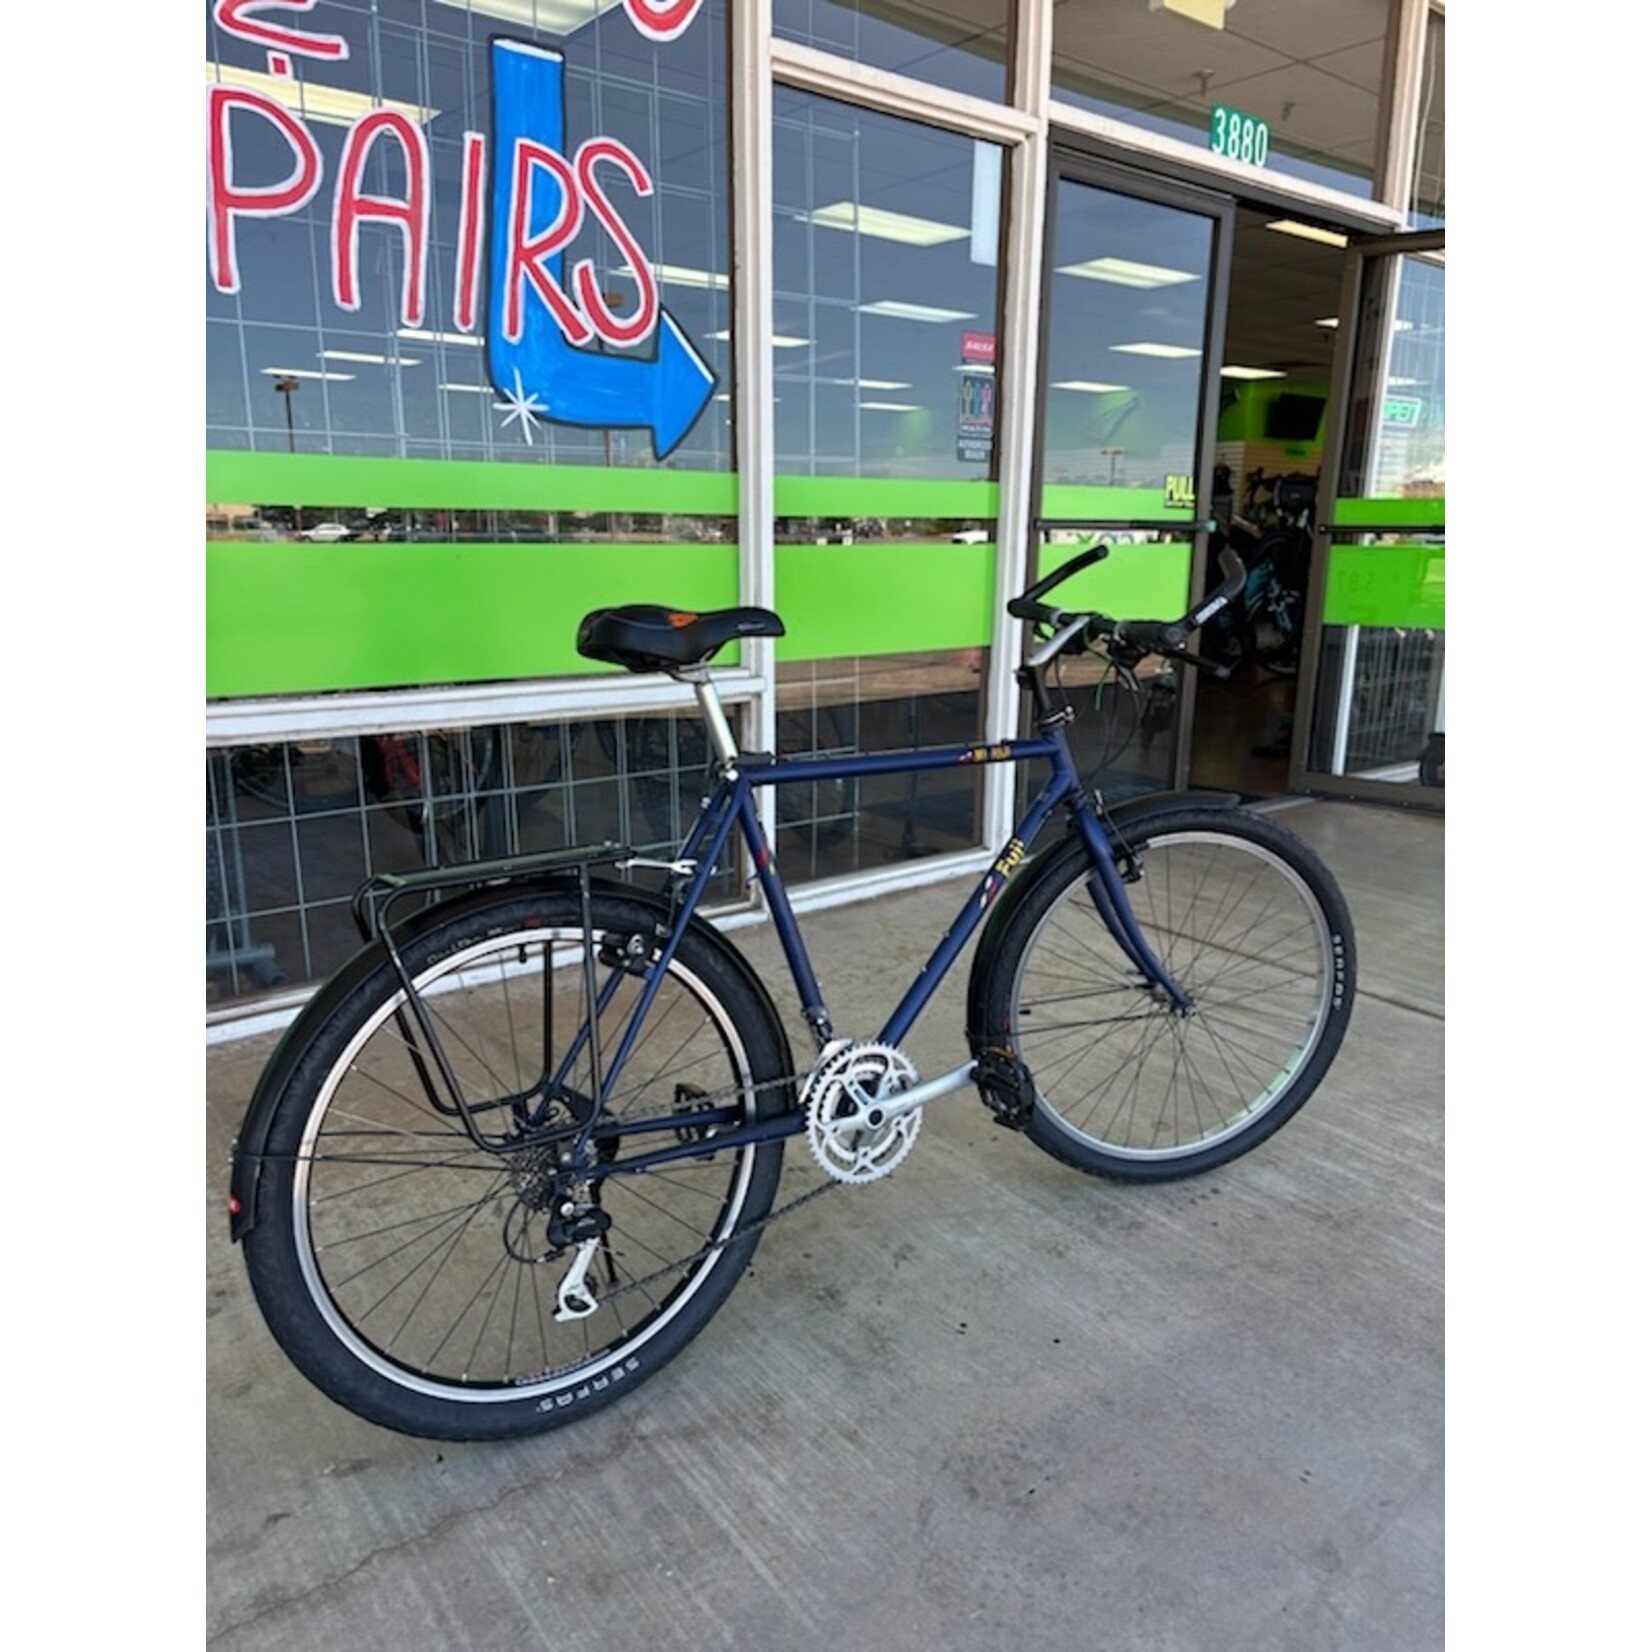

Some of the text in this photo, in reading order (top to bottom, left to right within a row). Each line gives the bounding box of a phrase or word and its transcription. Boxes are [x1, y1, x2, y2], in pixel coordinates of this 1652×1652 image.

[1212, 108, 1268, 167] 3880
[206, 85, 658, 348] PAIRS
[1165, 475, 1195, 501] PULL
[995, 838, 1025, 877] Fuji
[536, 1356, 640, 1413] SERFAS
